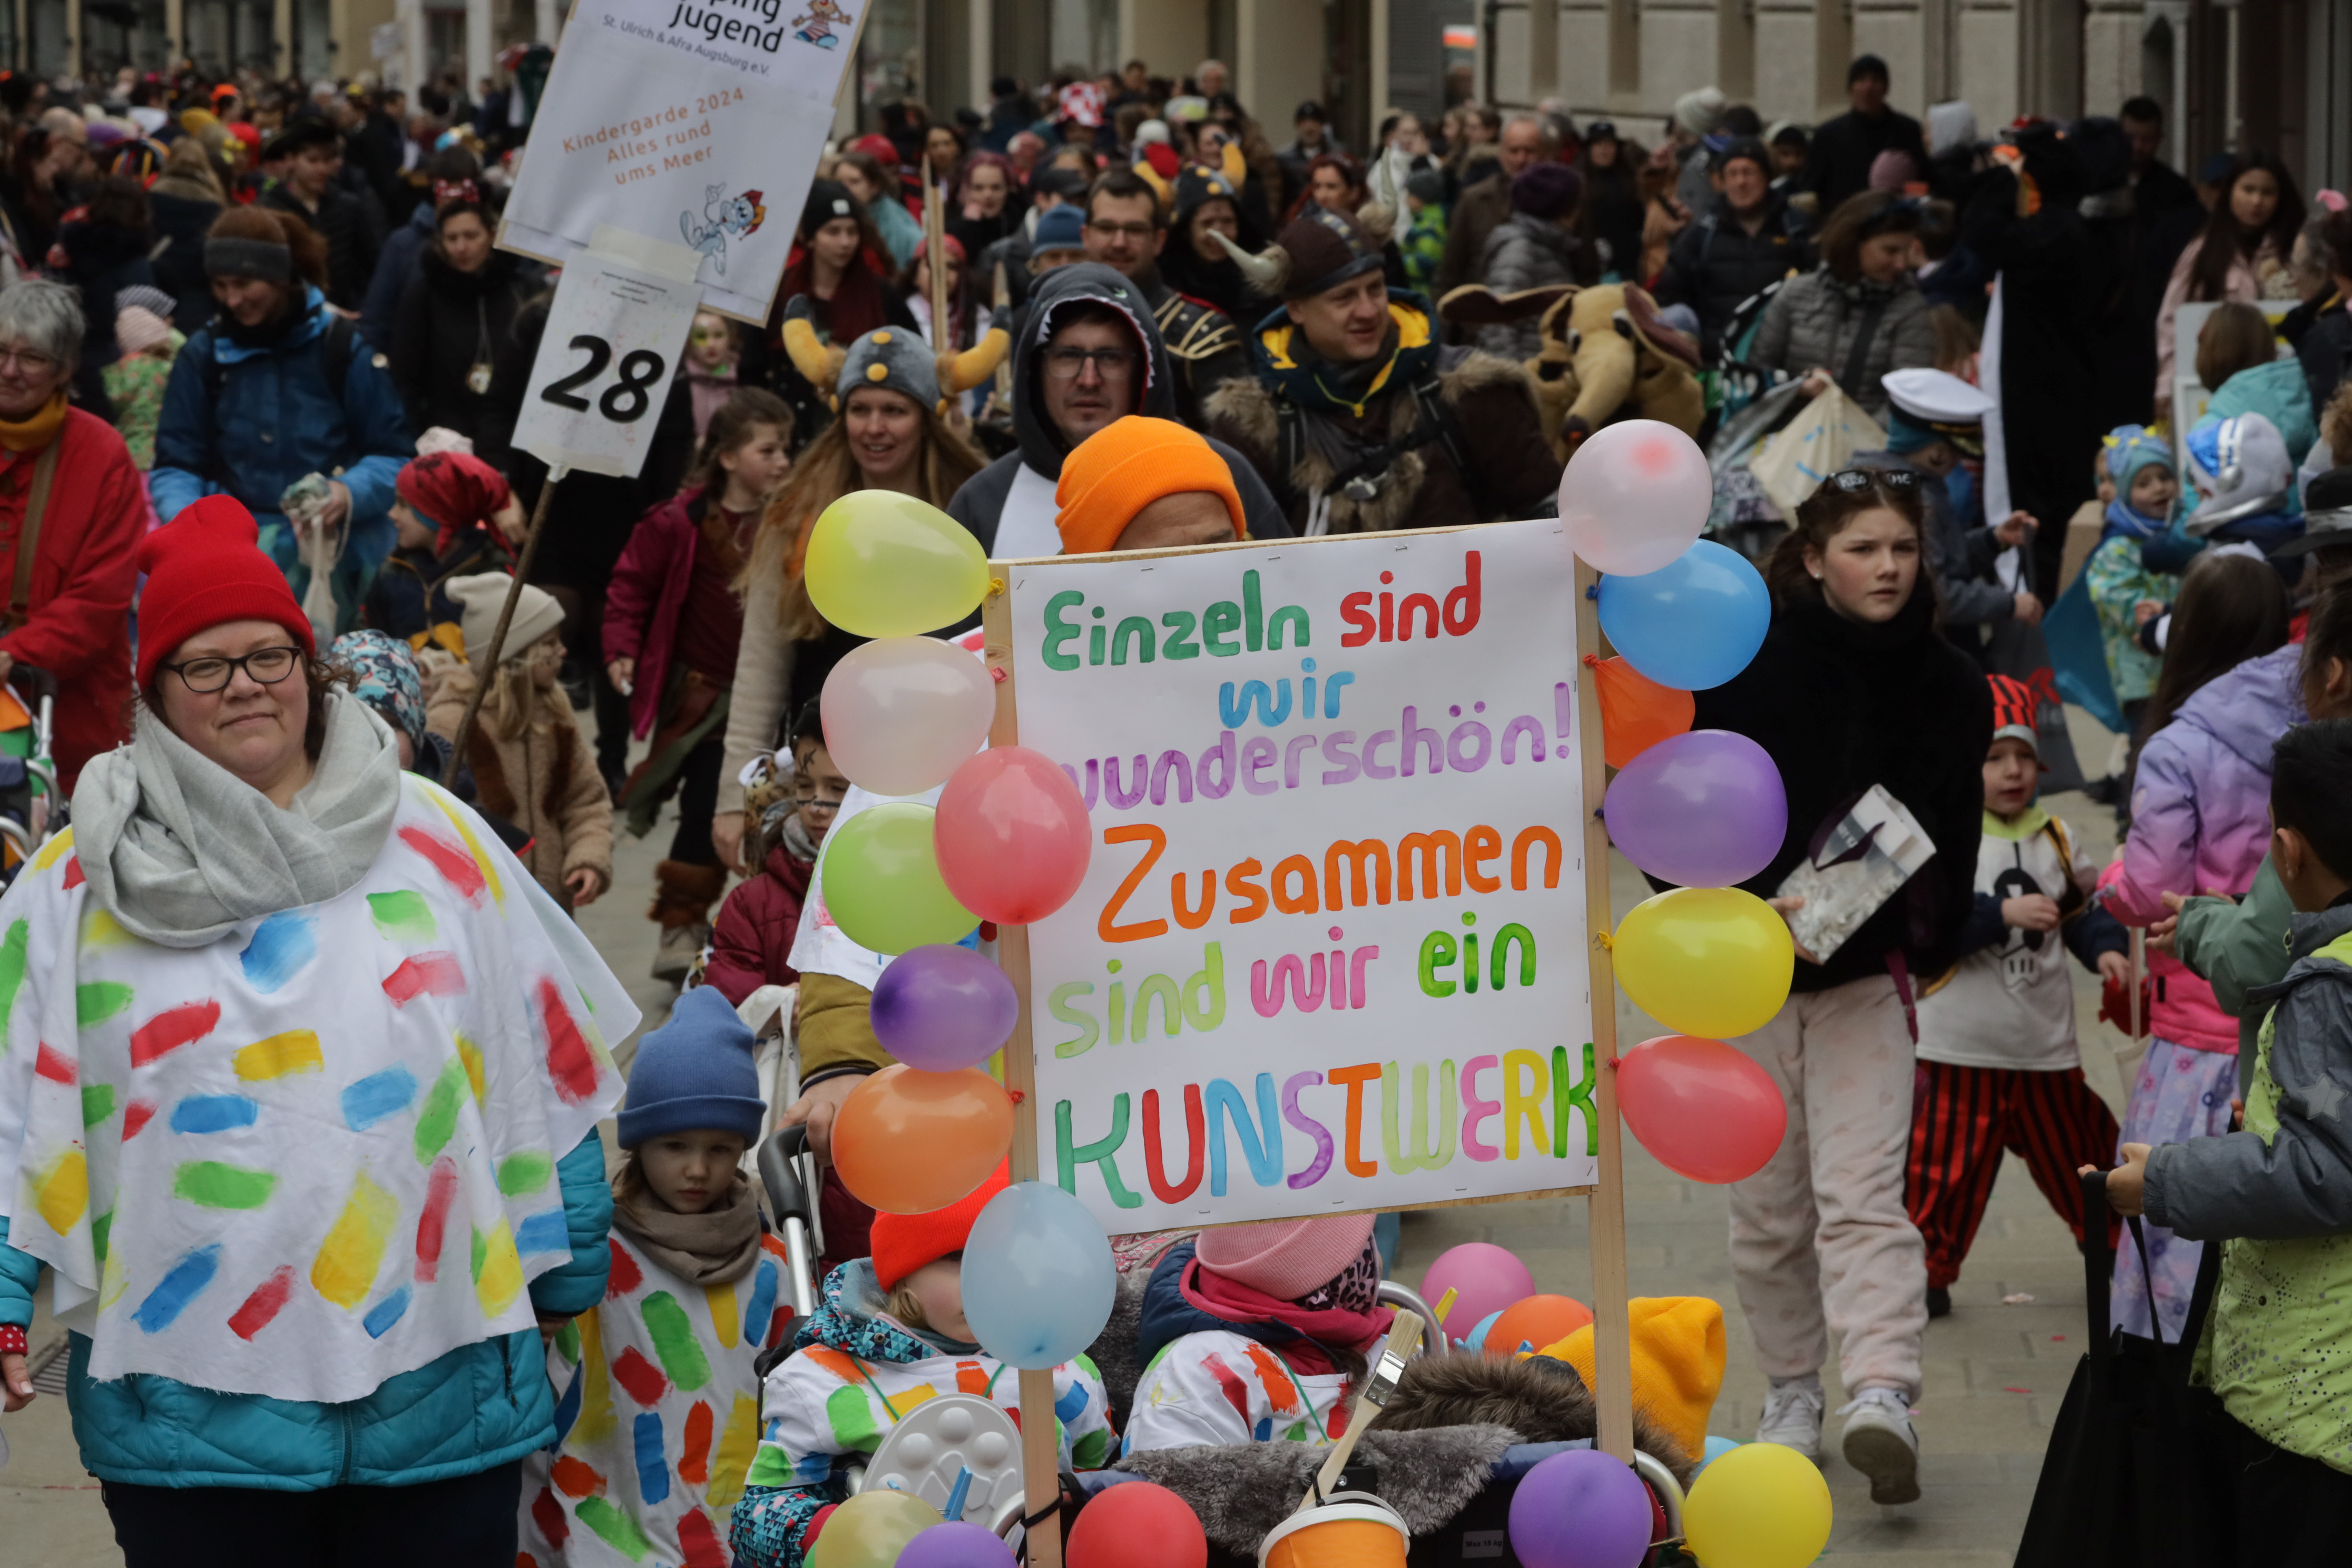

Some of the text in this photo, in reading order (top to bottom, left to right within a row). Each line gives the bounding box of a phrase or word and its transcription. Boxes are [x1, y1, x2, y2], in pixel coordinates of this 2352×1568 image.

[621, 20, 654, 39] Ulrich
[656, 31, 664, 43] &
[667, 35, 692, 52] Afra
[695, 44, 749, 71] Augsburg
[668, 0, 784, 52] jugend
[562, 87, 743, 154] Kindergarde 2024
[607, 120, 711, 164] Alles rund
[615, 145, 712, 184] ums Meer
[541, 335, 665, 424] 28
[1042, 550, 1482, 671] Einzeln sind
[1219, 657, 1356, 729] wir
[1097, 823, 1563, 944] Zusammen
[1048, 911, 1537, 1059] sind wir ein
[1054, 1043, 1599, 1209] KUNSTWERK
